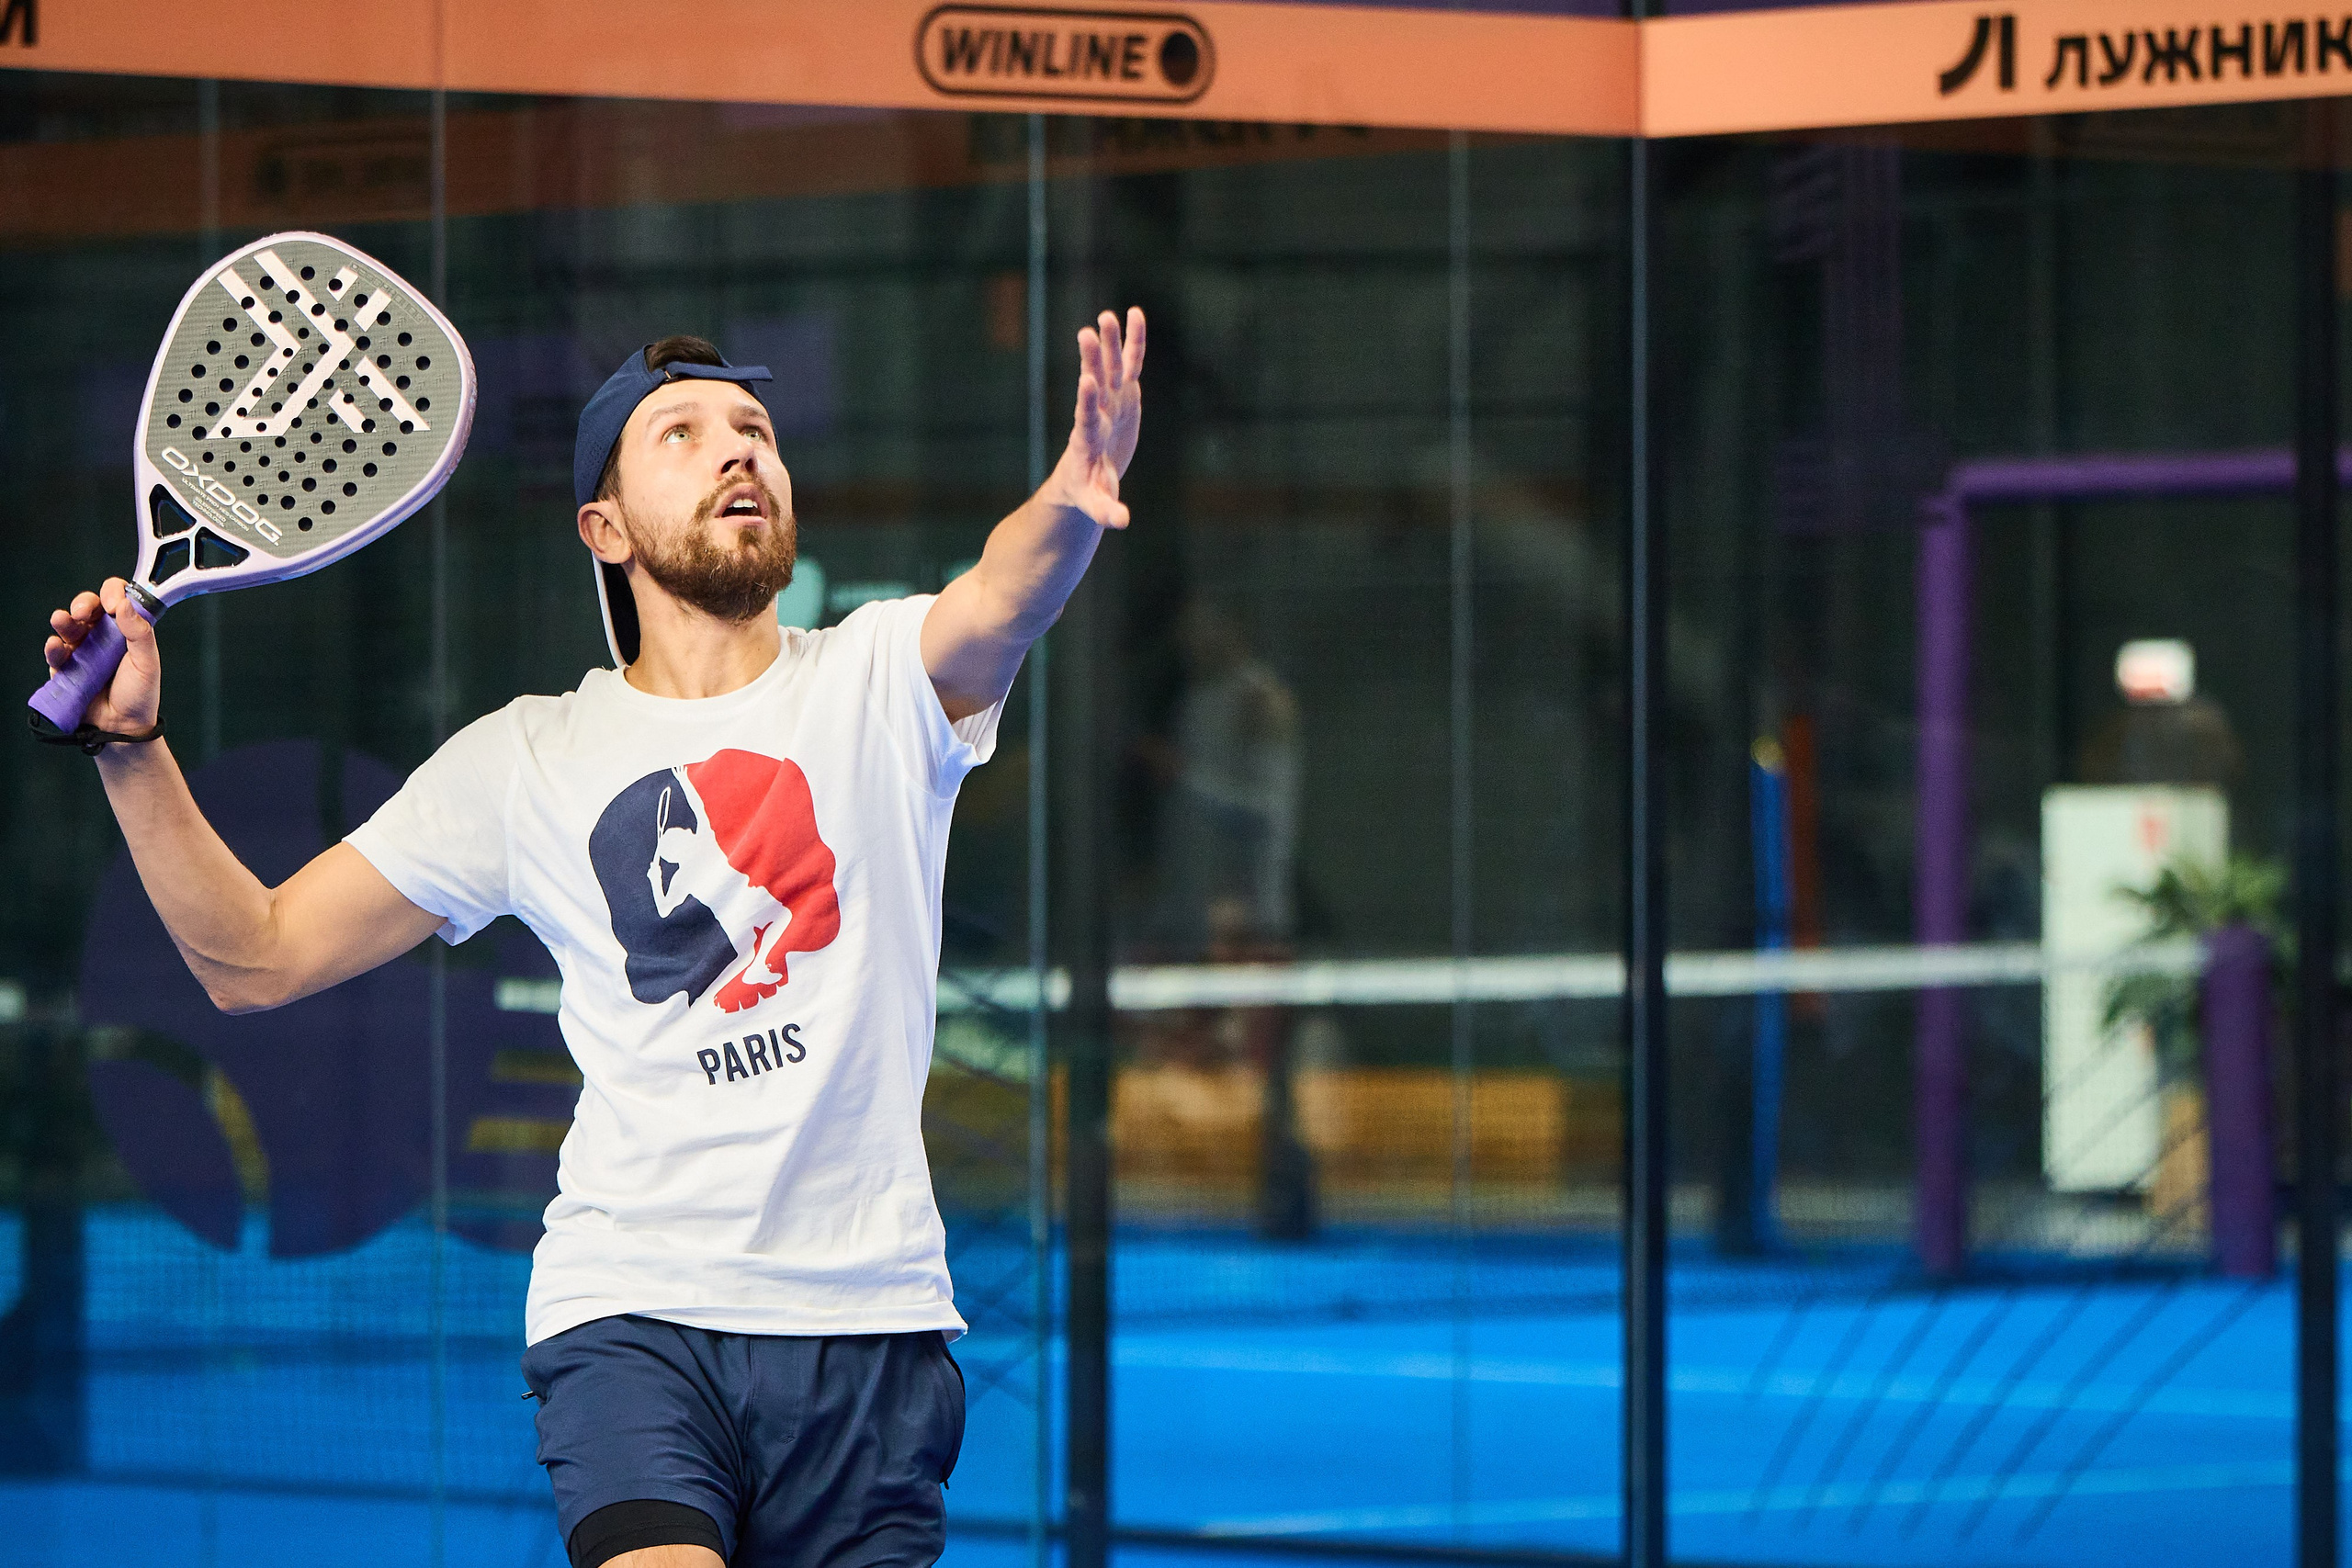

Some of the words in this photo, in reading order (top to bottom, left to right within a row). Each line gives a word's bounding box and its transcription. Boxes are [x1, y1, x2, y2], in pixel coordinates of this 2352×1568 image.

[942, 26, 1148, 81] WINLINE
[2045, 17, 2352, 89] ЛУЖНИК
[696, 1023, 807, 1085] PARIS
